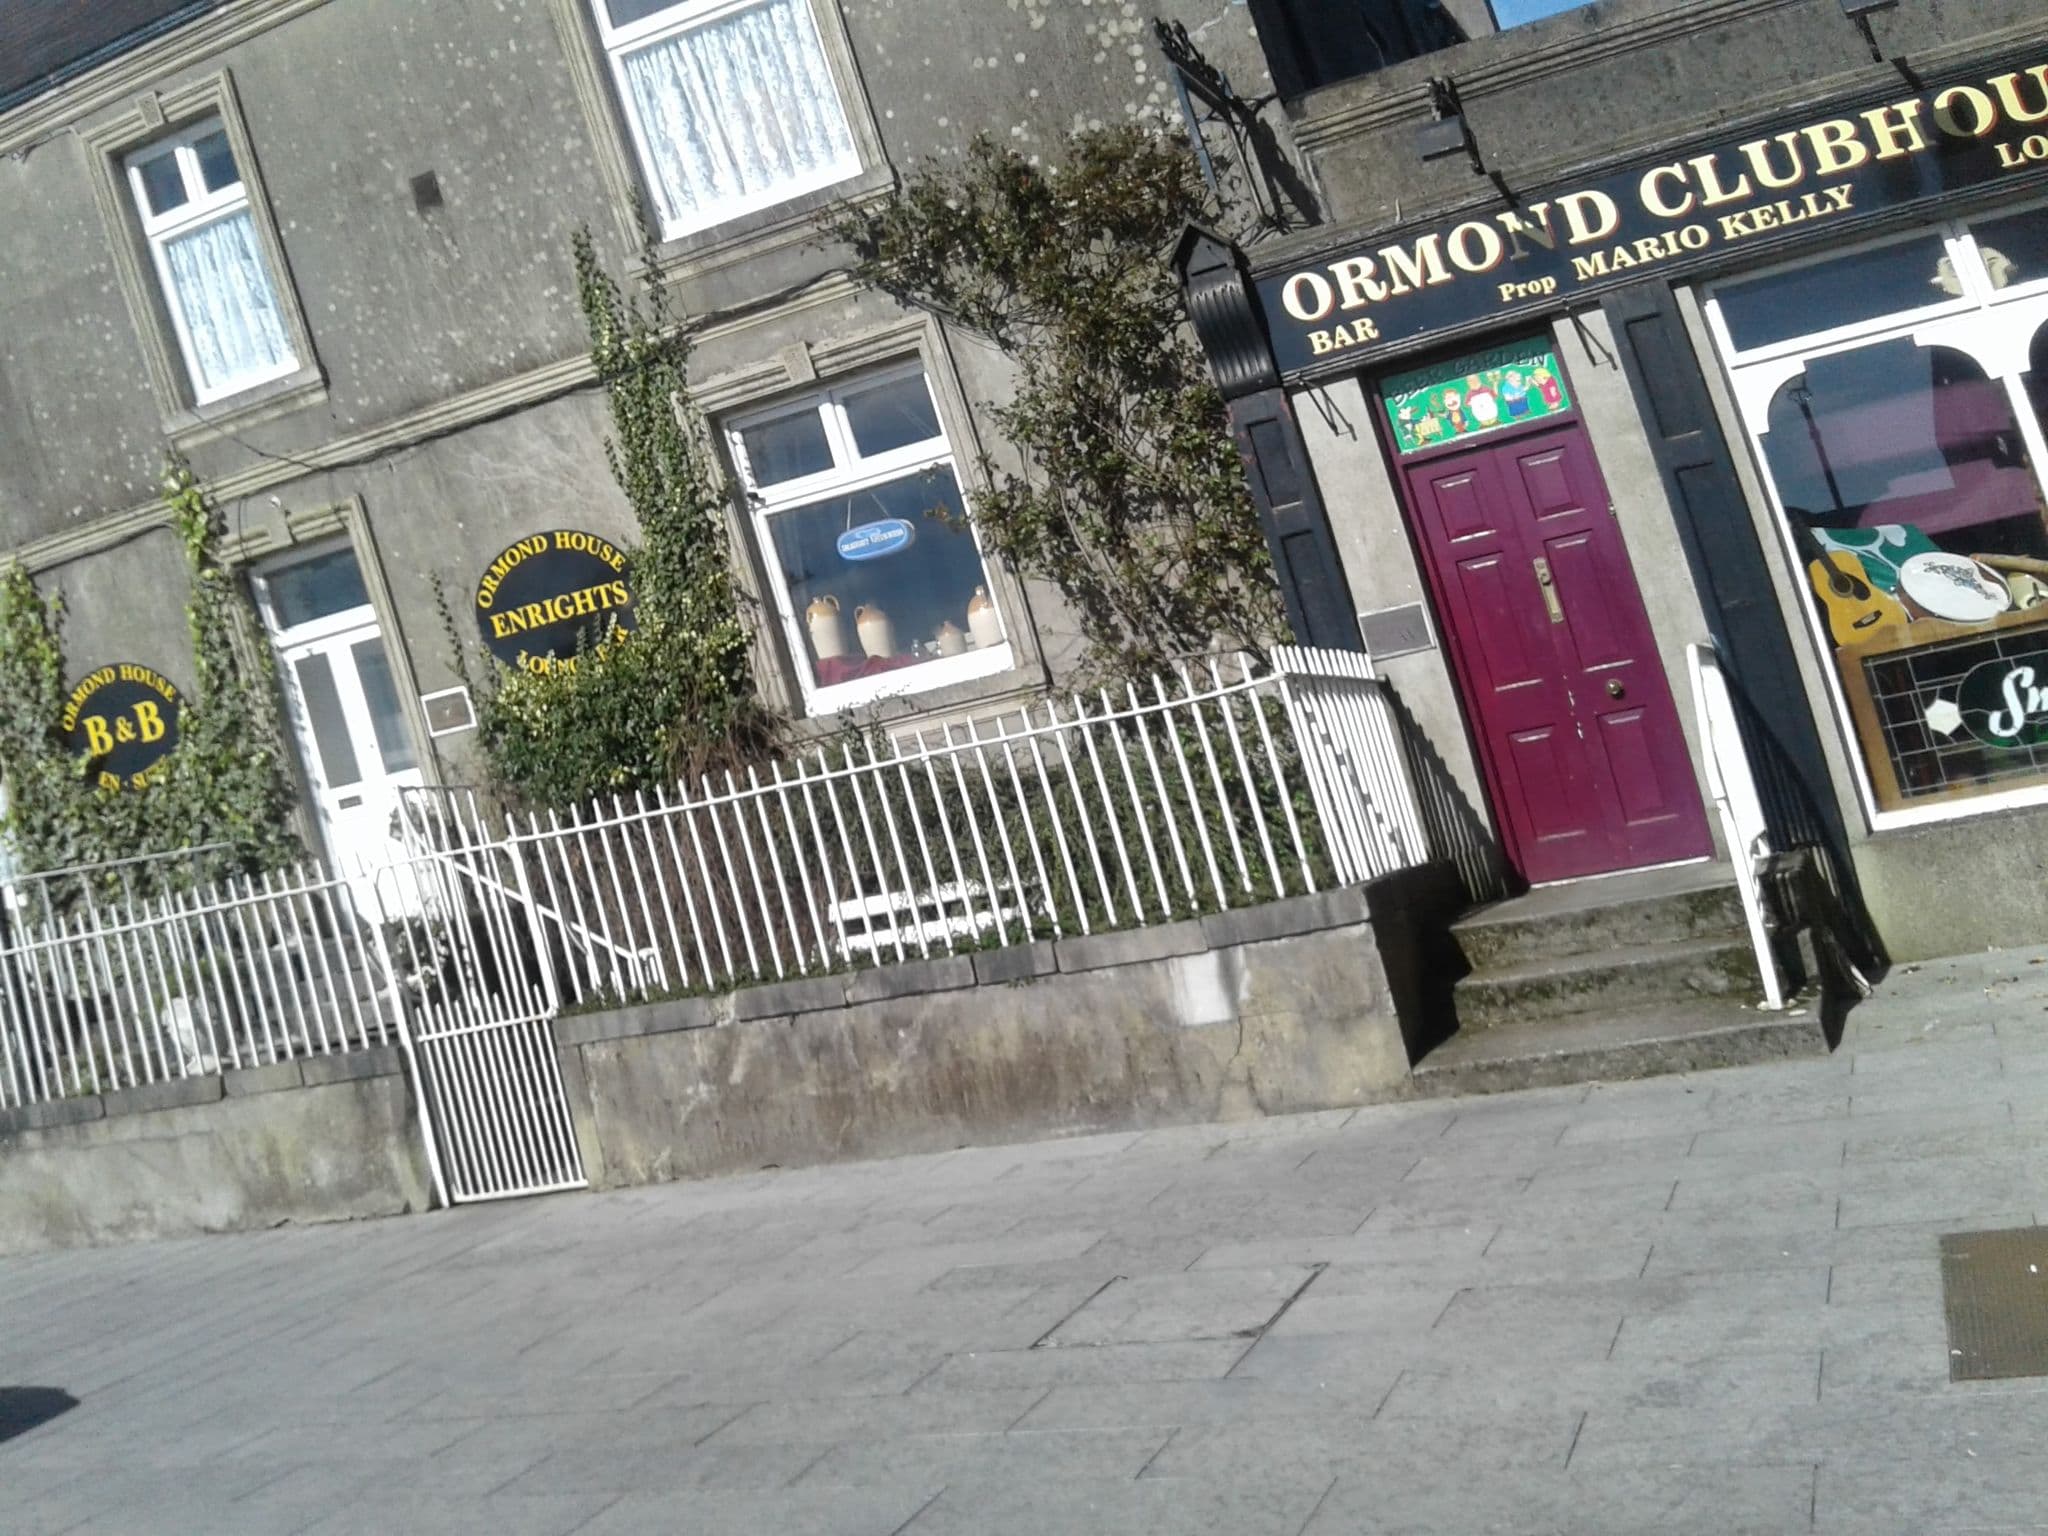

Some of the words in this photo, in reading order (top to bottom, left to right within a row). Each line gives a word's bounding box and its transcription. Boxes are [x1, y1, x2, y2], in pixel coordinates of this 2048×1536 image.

[1281, 190, 1619, 321] ORMOND
[1638, 64, 2048, 218] CLUBHOU
[1308, 317, 1380, 356] BAR
[1498, 275, 1557, 302] Prop
[1571, 224, 1710, 282] MARIO
[1717, 183, 1854, 241] KELLY
[477, 535, 548, 608] ORMOND
[554, 531, 626, 573] HOUSE
[489, 580, 629, 639] ENRIGHTS
[62, 667, 116, 732] ORMOND
[119, 664, 177, 703] HOUSE
